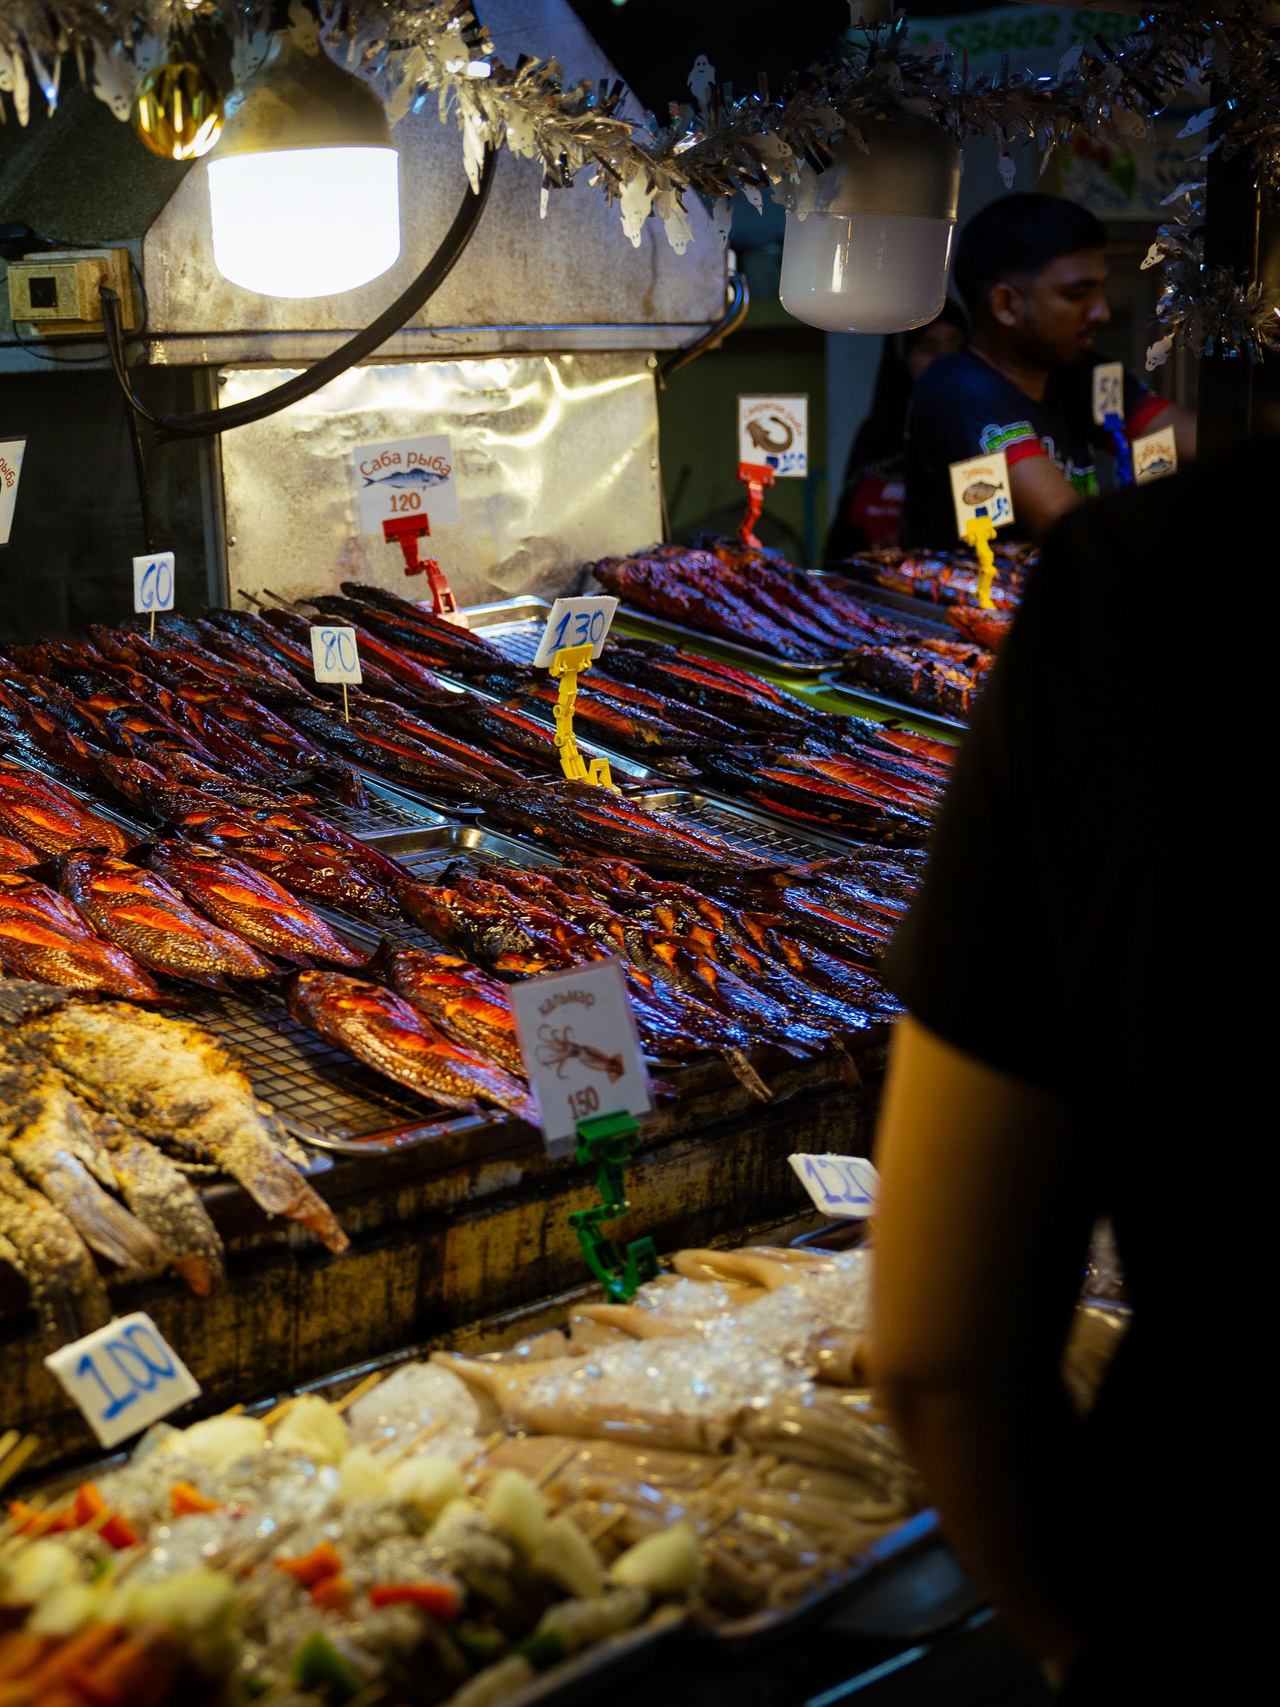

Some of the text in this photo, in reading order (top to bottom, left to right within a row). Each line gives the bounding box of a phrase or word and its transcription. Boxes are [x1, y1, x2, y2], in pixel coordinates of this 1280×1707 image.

[359, 450, 452, 477] Саба рыба
[389, 492, 422, 513] 120
[140, 561, 172, 609] 60
[320, 629, 357, 673] 80
[548, 608, 606, 653] 130
[567, 1085, 601, 1121] 150
[77, 1323, 177, 1421] 100
